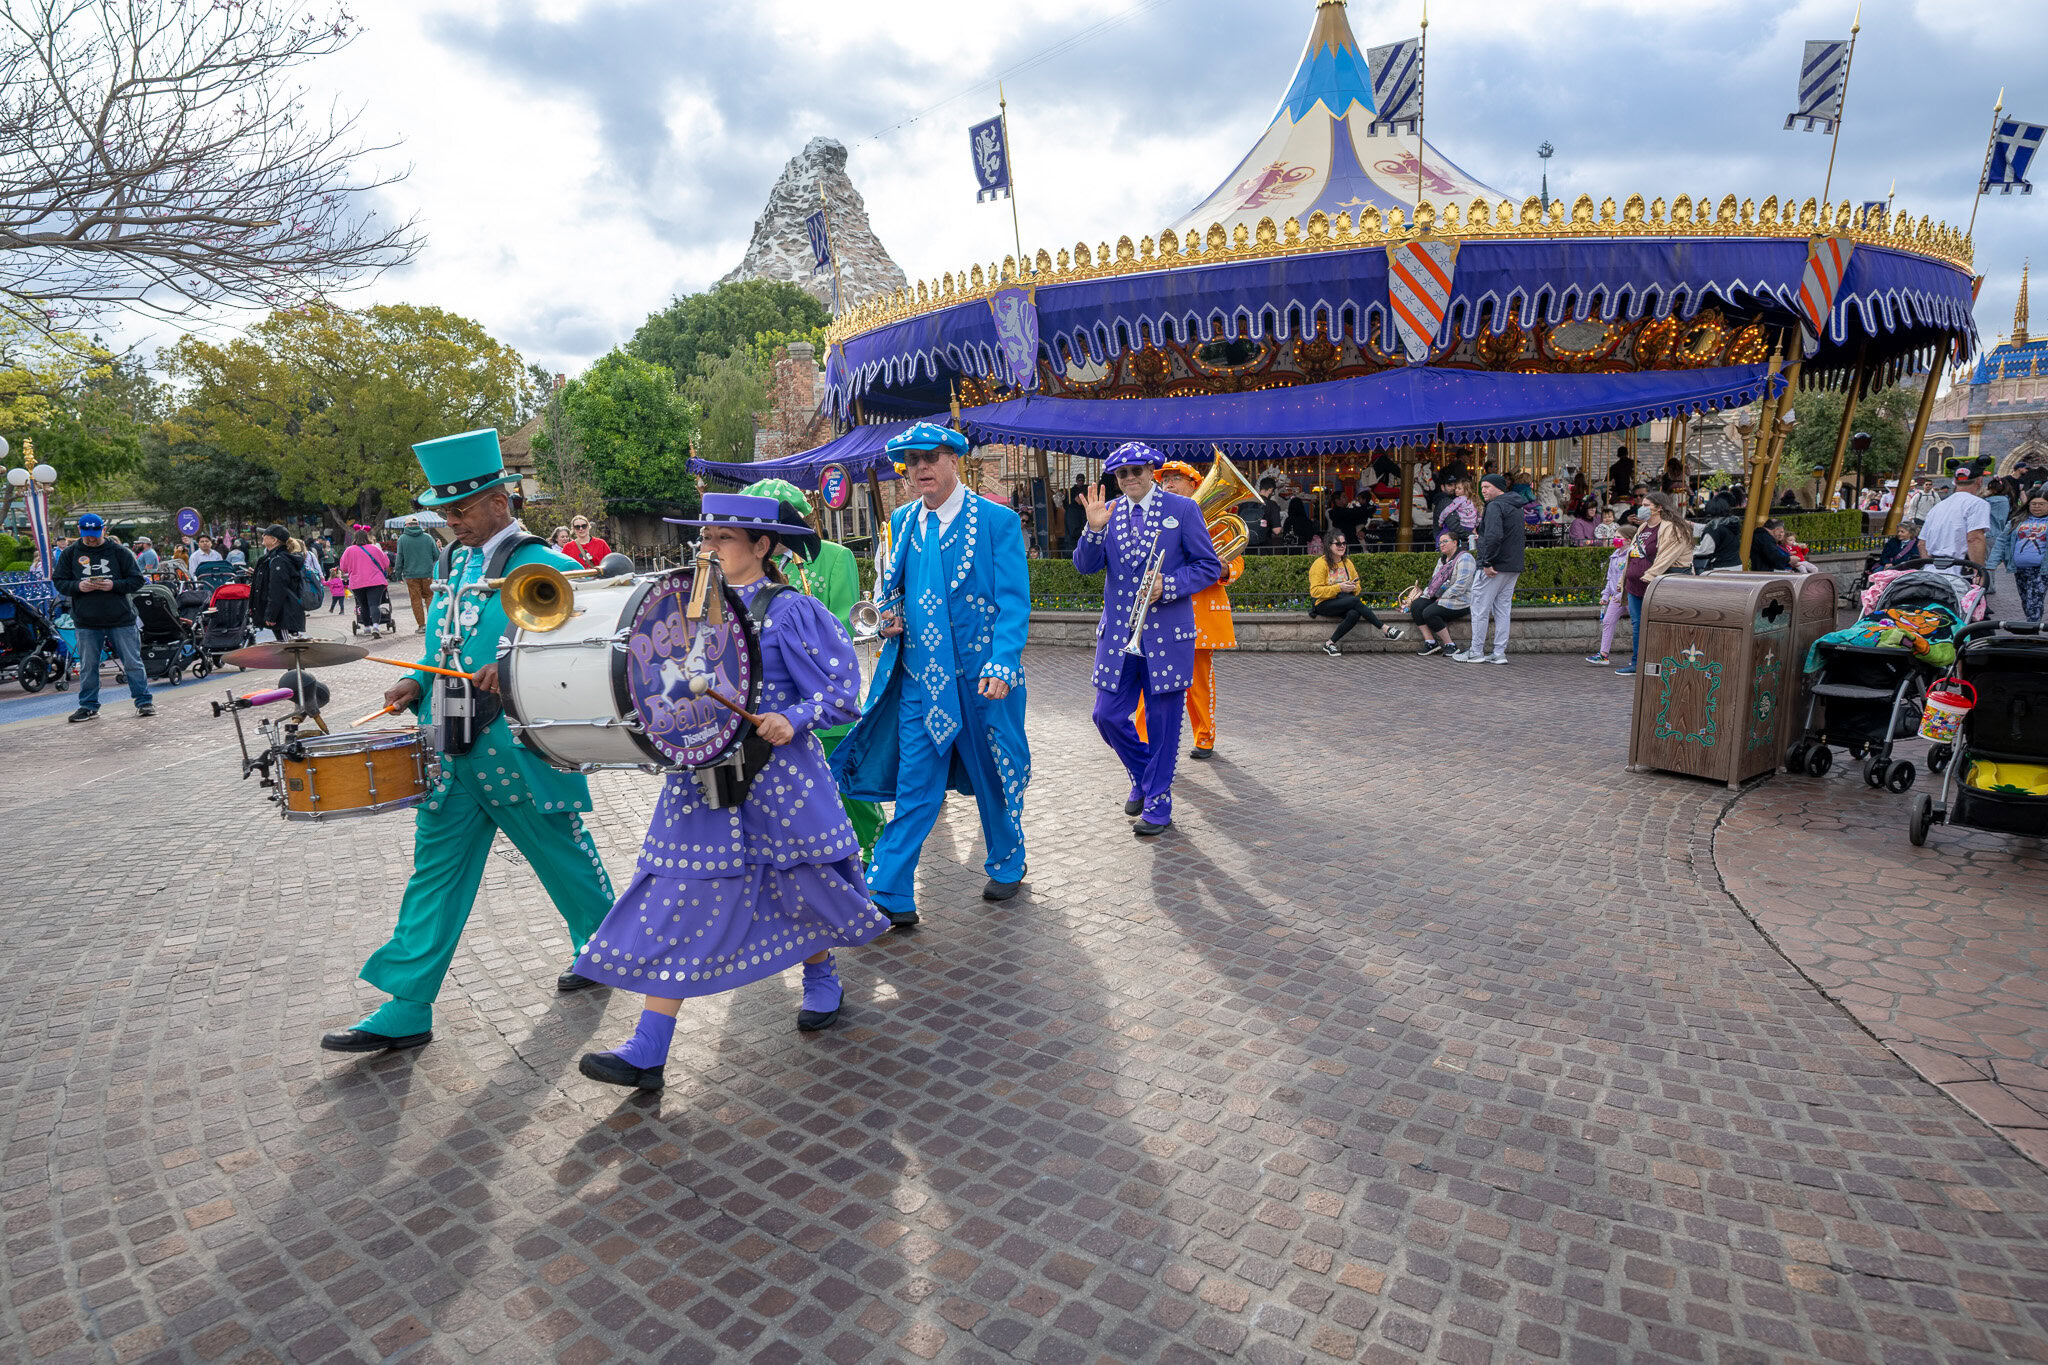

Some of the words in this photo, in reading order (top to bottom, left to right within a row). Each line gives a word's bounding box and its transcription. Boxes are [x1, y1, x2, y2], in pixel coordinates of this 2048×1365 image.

[630, 605, 730, 685] Peay
[644, 661, 741, 734] Band
[681, 722, 720, 748] Disneyland
